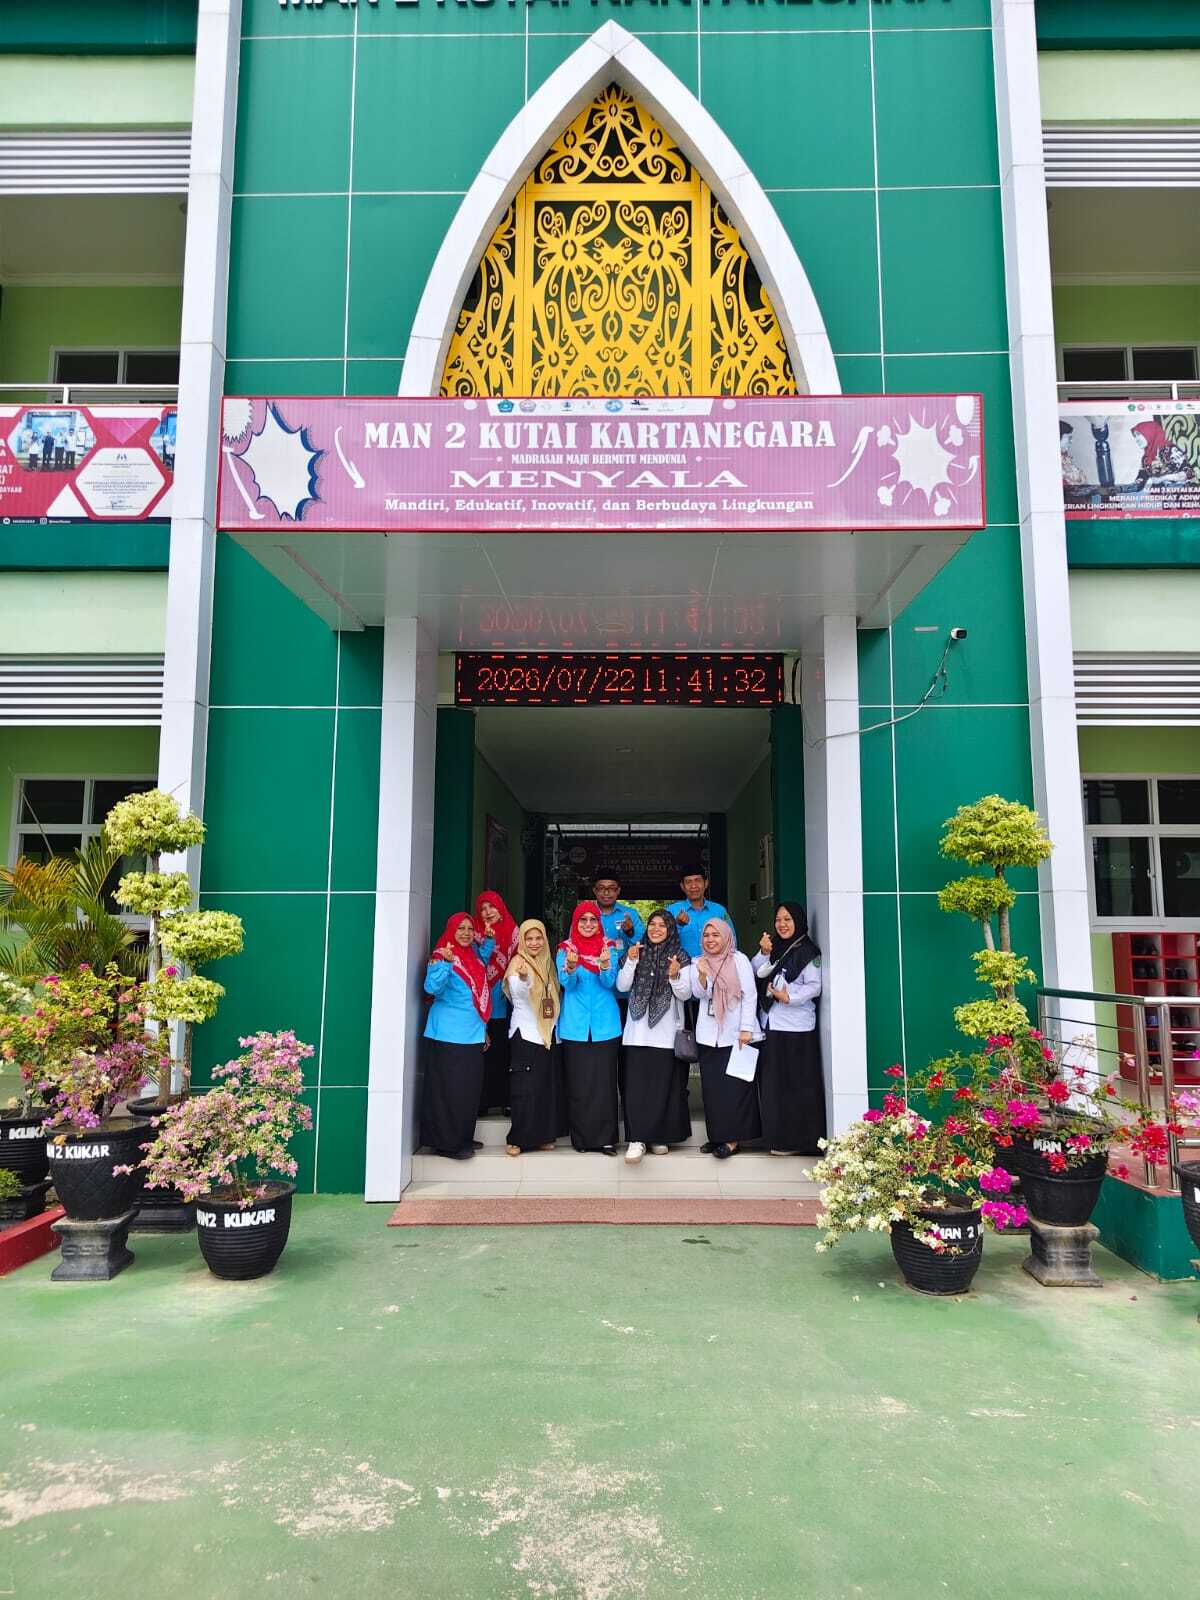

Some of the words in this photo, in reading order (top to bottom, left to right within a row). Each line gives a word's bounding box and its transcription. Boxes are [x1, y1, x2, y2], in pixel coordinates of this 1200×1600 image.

[364, 422, 433, 449] MAN
[445, 422, 467, 449] 2
[479, 422, 578, 449] KUTAI
[590, 420, 837, 449] KARTANEGARA
[511, 453, 563, 465] MADRASAH
[566, 453, 589, 465] MAJU
[592, 453, 636, 465] BERMUTU
[639, 453, 687, 465] MENDUNIA
[449, 469, 749, 489] MENYALA
[384, 499, 450, 513] Mandiri,
[455, 499, 527, 513] Edukatif,
[531, 499, 597, 513] Inovatif,
[602, 499, 631, 511] dan
[636, 499, 717, 514] Berbudaya
[722, 498, 815, 513] Lingkungan
[65, 1143, 110, 1159] KUKAR
[224, 1208, 276, 1228] KUKAR
[967, 1226, 975, 1239] 2
